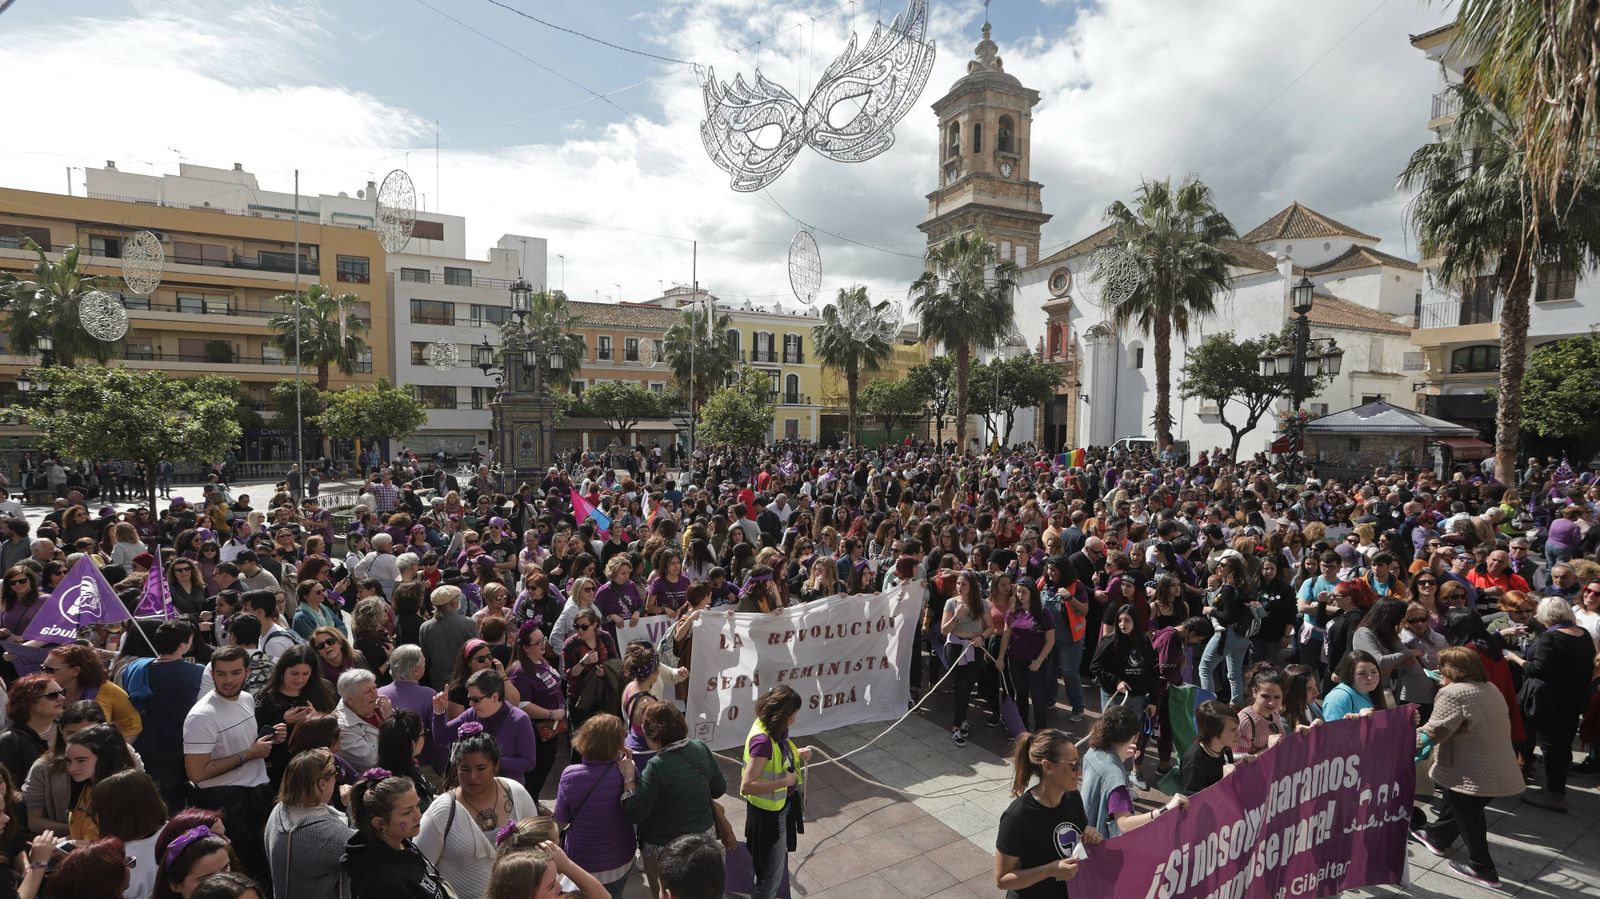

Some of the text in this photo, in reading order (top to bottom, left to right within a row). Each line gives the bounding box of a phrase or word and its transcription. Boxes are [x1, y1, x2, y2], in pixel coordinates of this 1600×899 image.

[719, 615, 896, 650] LA REVOLUCIÓN
[707, 656, 890, 692] SERÁ FEMINISTA
[728, 705, 739, 721] O
[809, 686, 857, 709] SERÁ
[1265, 754, 1361, 824] paramos,
[1255, 833, 1280, 878] se
[1280, 800, 1336, 867] para!
[1290, 861, 1351, 895] Gibaltar
